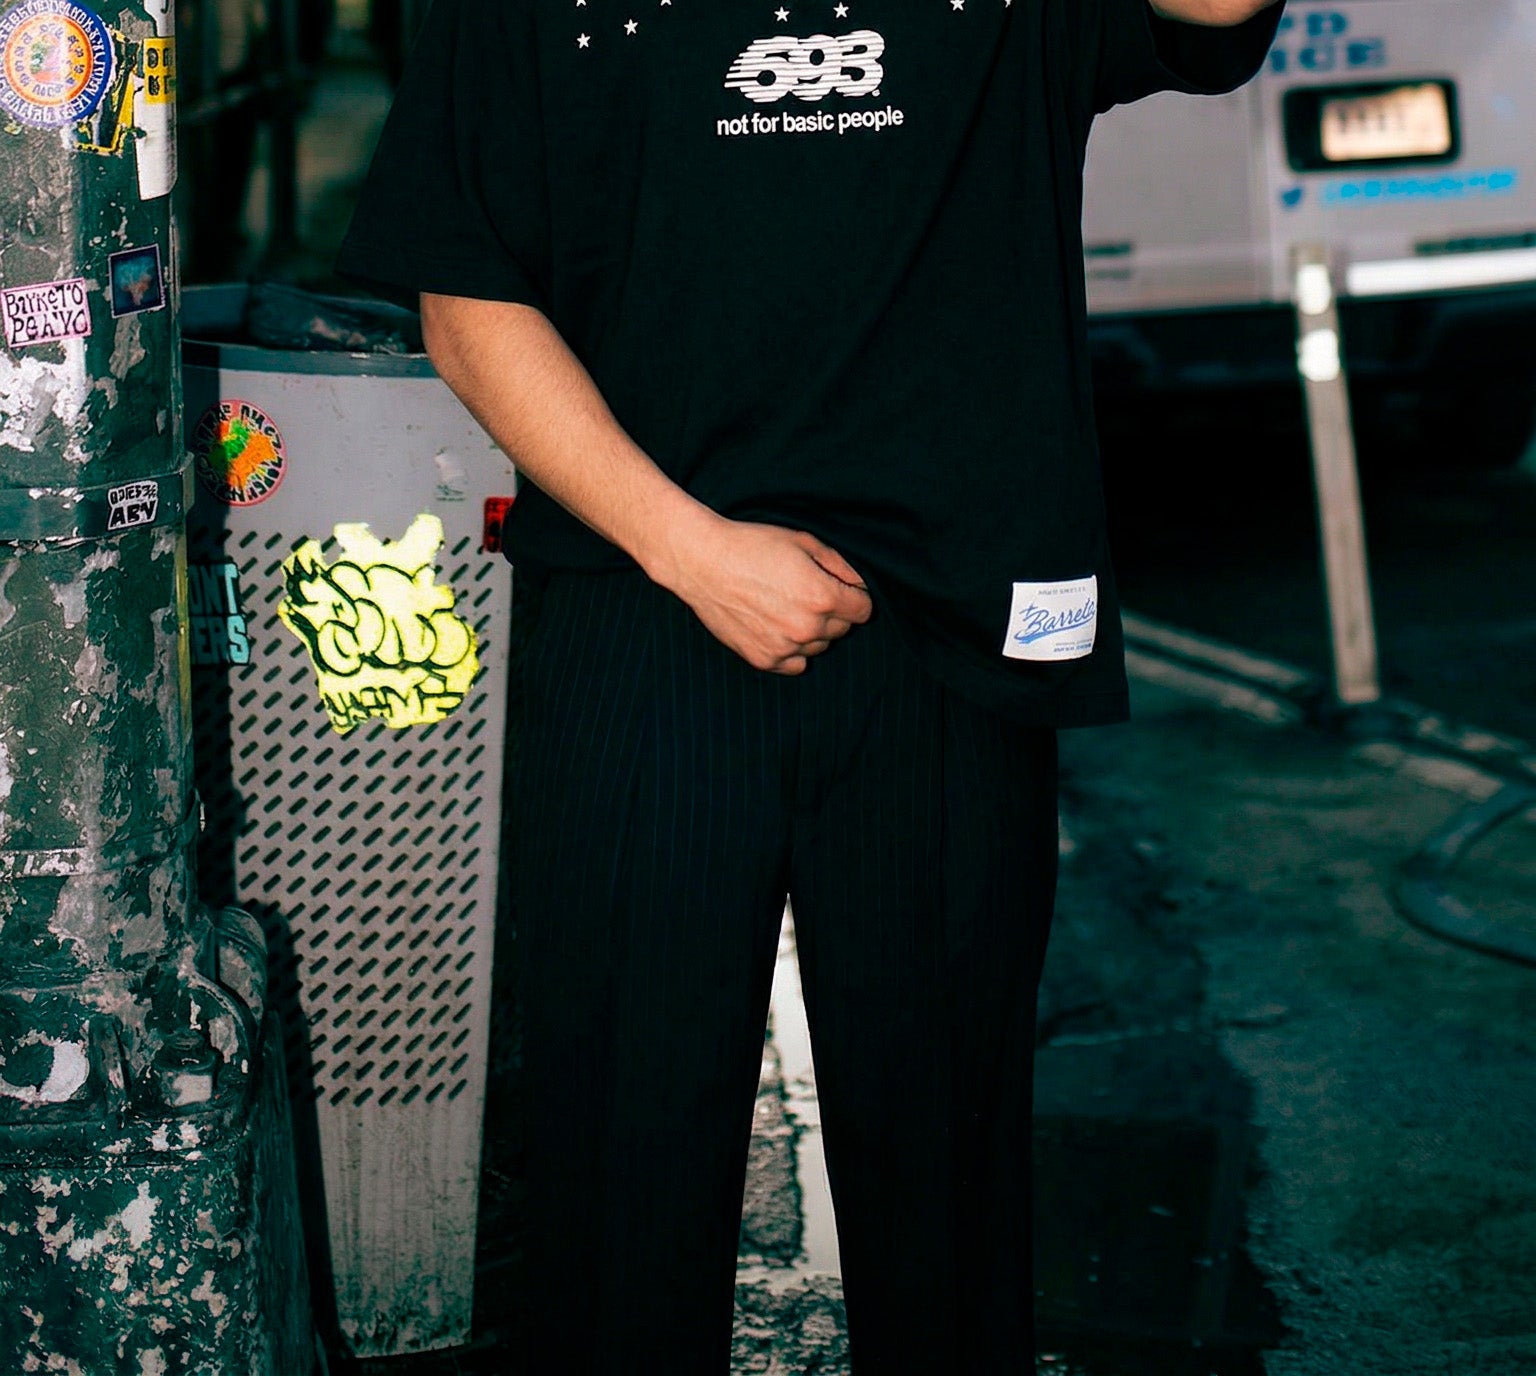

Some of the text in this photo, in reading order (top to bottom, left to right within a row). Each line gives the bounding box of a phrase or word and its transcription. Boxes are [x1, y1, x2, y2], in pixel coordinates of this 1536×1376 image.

[716, 105, 904, 136] not for basic people
